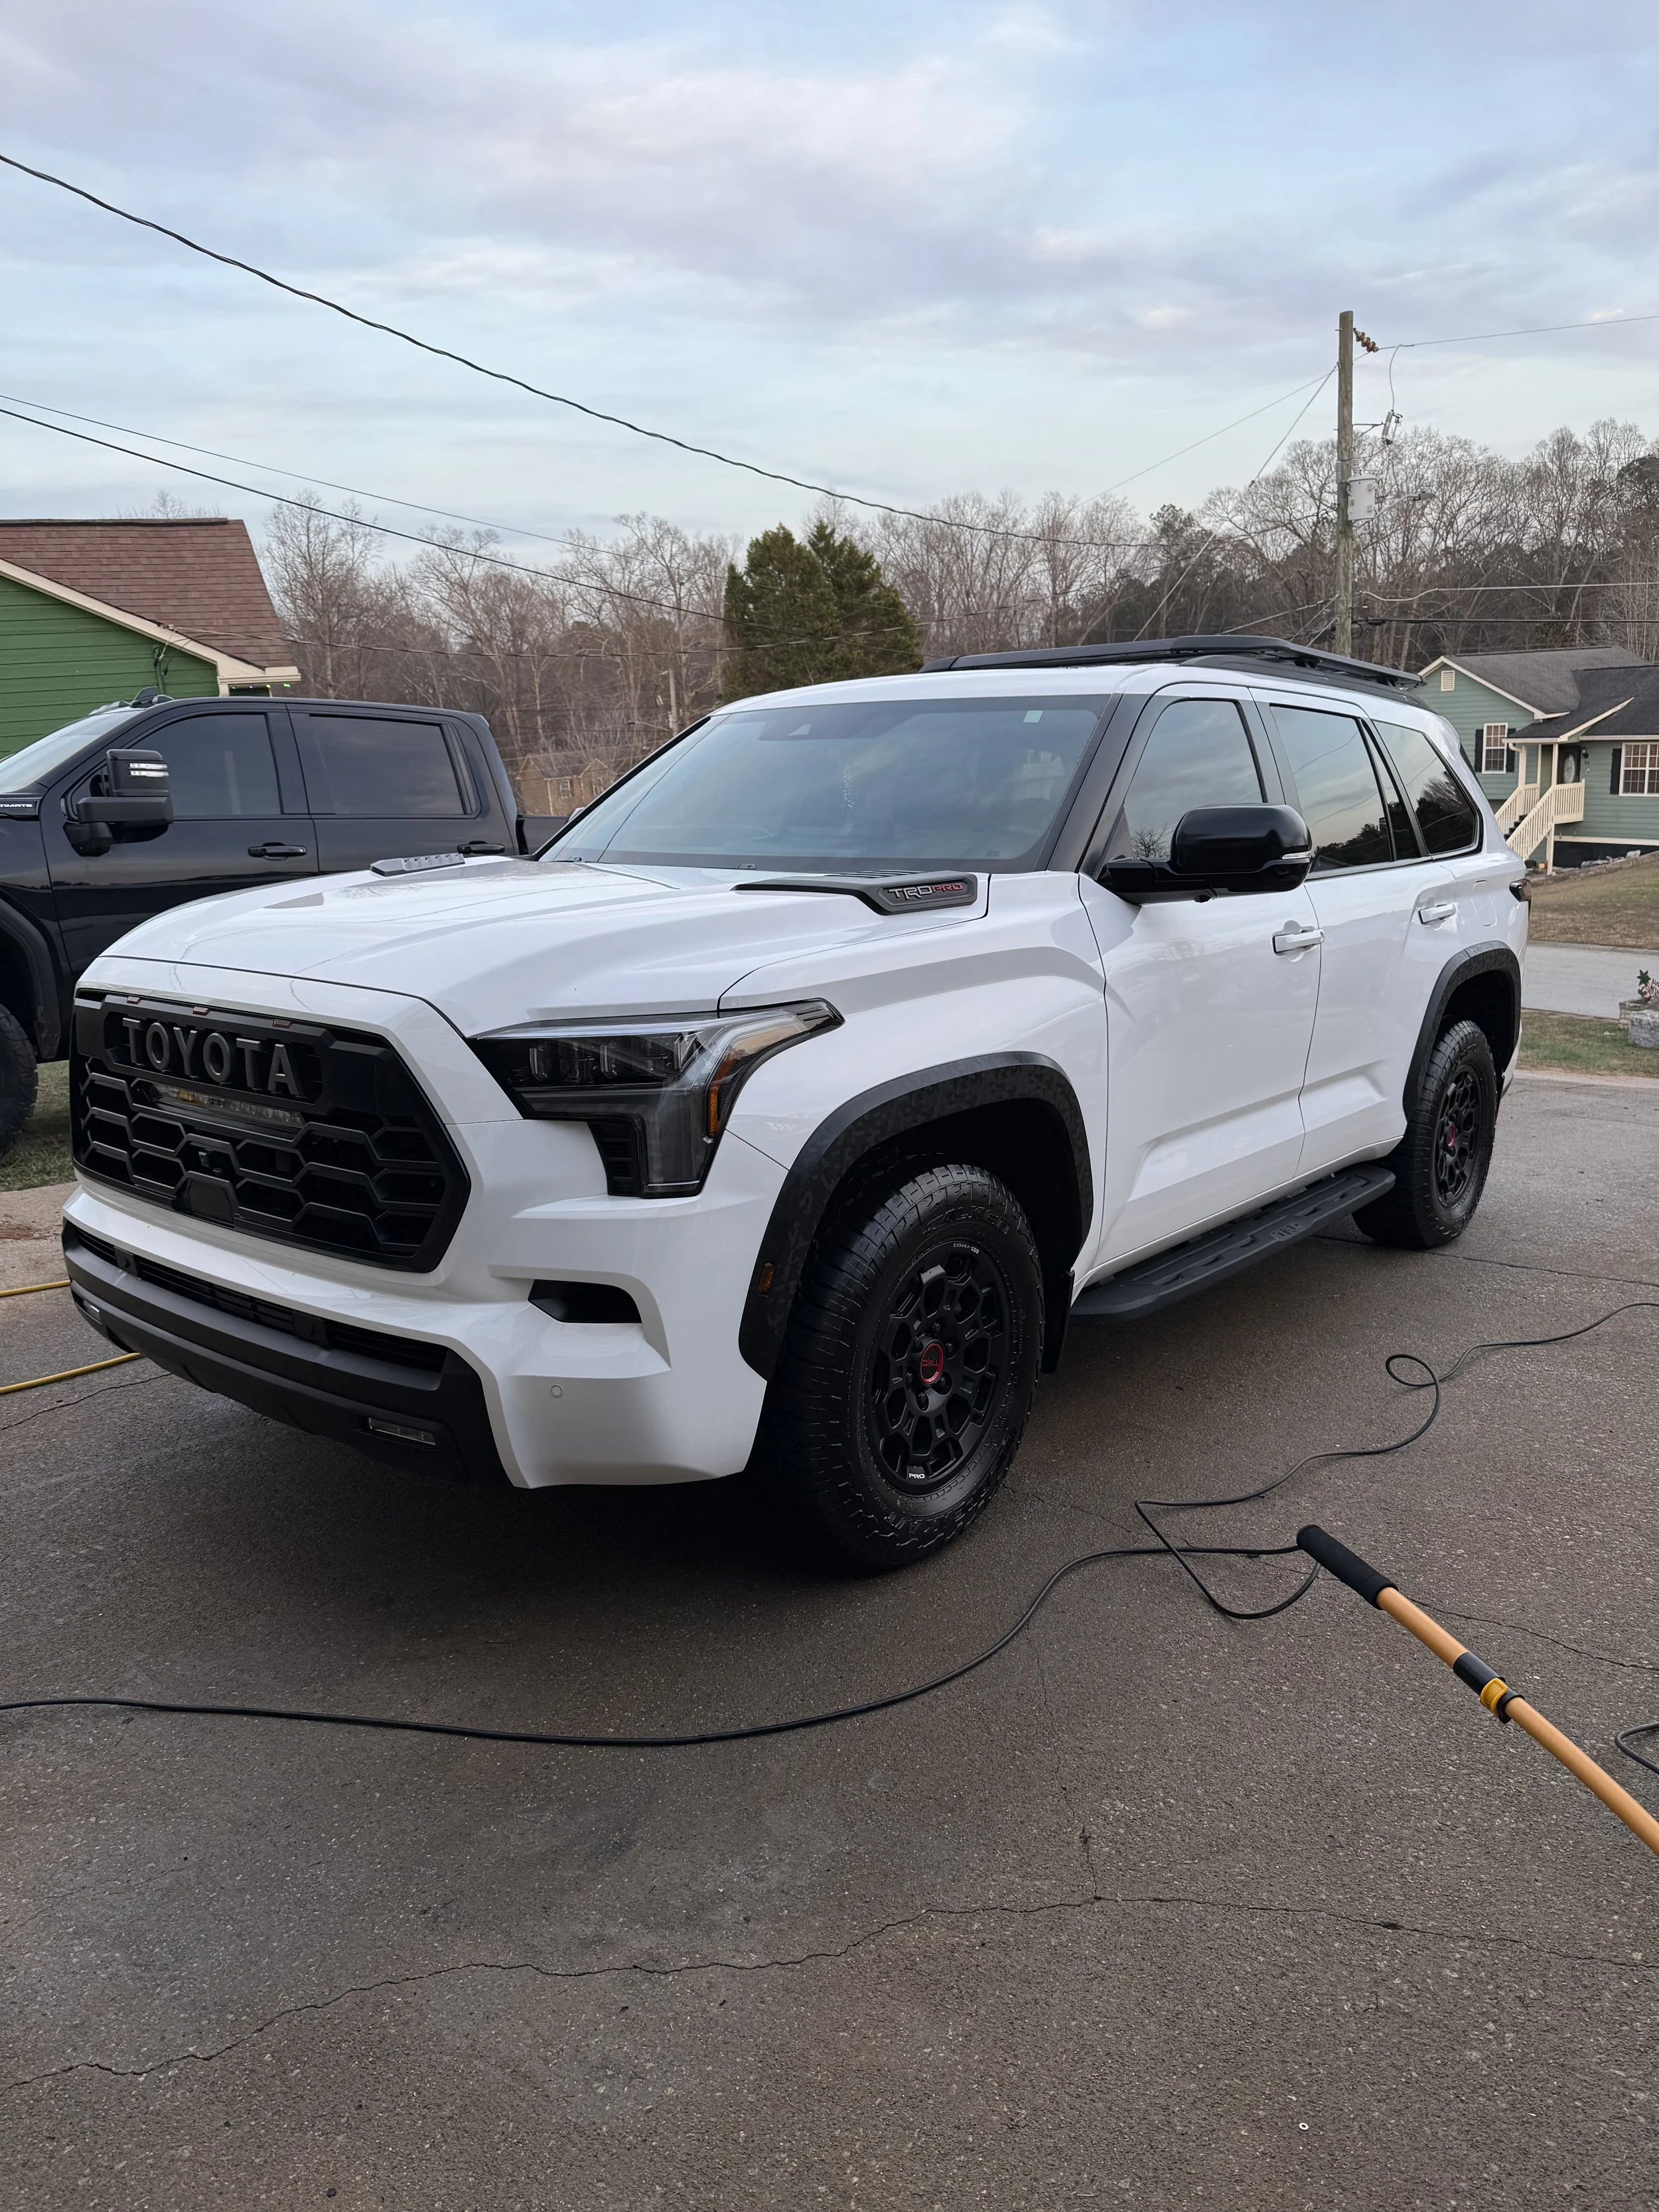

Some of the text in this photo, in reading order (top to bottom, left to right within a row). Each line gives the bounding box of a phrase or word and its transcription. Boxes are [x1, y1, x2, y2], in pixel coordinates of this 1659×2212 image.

[888, 883, 964, 900] TRD PRO
[122, 1017, 301, 1096] TOYOTA
